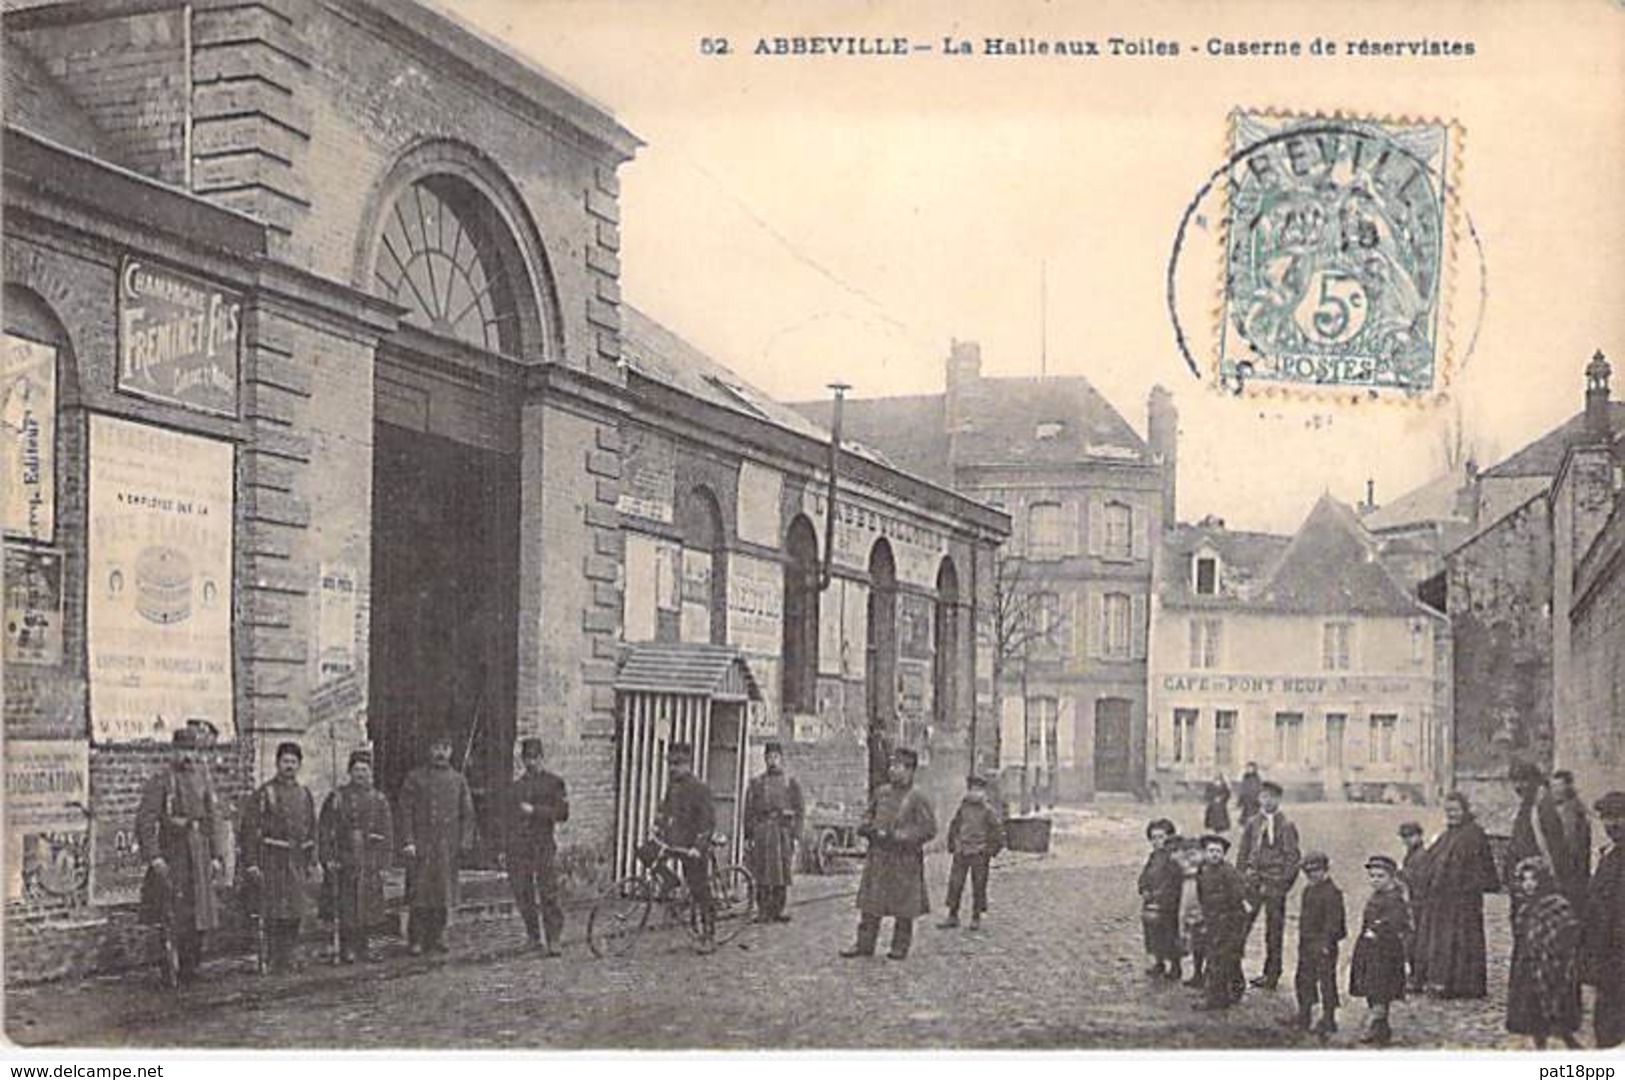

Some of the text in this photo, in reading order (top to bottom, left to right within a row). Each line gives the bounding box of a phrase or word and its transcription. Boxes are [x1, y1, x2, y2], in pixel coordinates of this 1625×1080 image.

[754, 37, 908, 55] ABBEVILLE
[943, 37, 974, 55] La
[983, 37, 1050, 55] Halle
[1054, 40, 1100, 55] aux
[1108, 37, 1180, 56] Toiles
[1206, 37, 1302, 56] Caserne
[1309, 37, 1337, 56] de
[1346, 38, 1476, 56] réservistes
[1279, 356, 1378, 384] POSTES
[1227, 675, 1276, 693] PONT
[1283, 676, 1329, 694] NEUF
